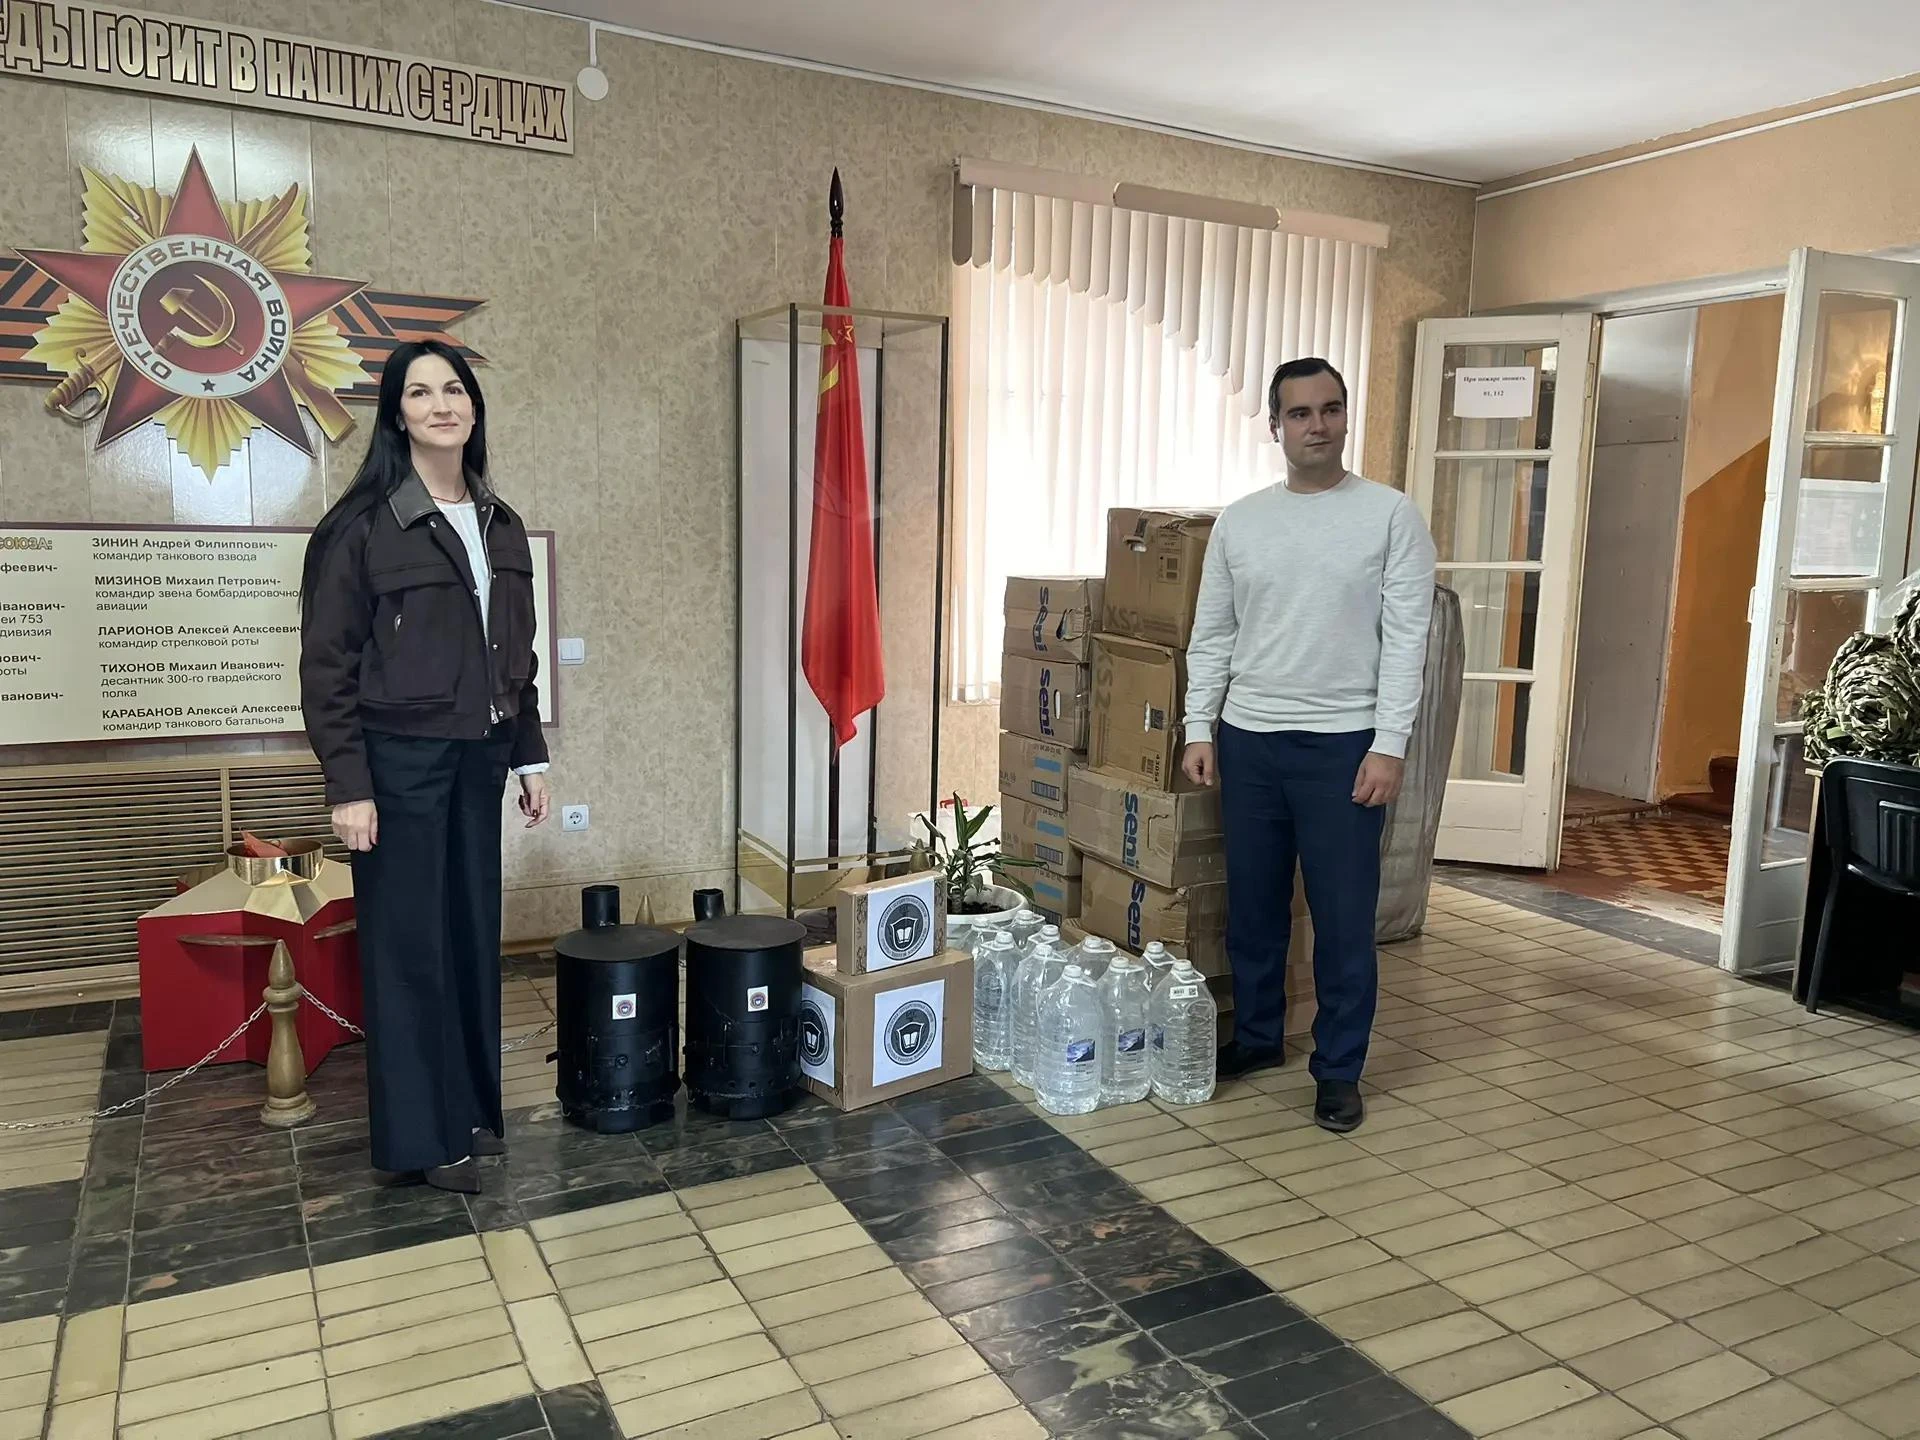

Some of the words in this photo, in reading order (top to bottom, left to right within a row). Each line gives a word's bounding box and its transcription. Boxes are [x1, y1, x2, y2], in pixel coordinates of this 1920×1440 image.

[93, 10, 222, 89] ГОРИТ
[228, 31, 258, 93] В
[263, 37, 404, 118] НАШИХ
[406, 62, 568, 144] СЕРДЦАХ
[116, 241, 272, 381] ОТЕЧЕСТВЕННАЯ
[91, 537, 139, 548] ЗИНИН
[142, 538, 191, 550] Андрей
[194, 539, 278, 549] Филиппович-
[92, 552, 153, 563] командир
[155, 552, 215, 561] танкового
[217, 553, 257, 563] взвода
[94, 575, 162, 586] МИЗИНОВ
[165, 575, 214, 586] Михаил
[217, 576, 281, 588] Петрович-
[95, 590, 155, 600] командир
[158, 590, 193, 598] звена
[196, 589, 300, 600] бомбардировочно
[0, 602, 65, 611] ванович-
[96, 603, 148, 612] авиации
[20, 613, 44, 624] 753
[0, 628, 52, 638] дивизия
[97, 625, 174, 636] ЛАРИОНОВ
[177, 624, 229, 635] Алексей
[98, 640, 159, 650] командир
[161, 637, 228, 649] стрелковой
[231, 638, 259, 648] роты
[99, 662, 166, 674] ТИХОНОВ
[169, 662, 217, 672] Михаил
[220, 661, 285, 671] Иванович-
[100, 676, 164, 687] десантник
[166, 673, 204, 684] 300-го
[207, 672, 282, 684] гвардейского
[102, 689, 137, 699] полка
[1039, 667, 1055, 737] seni
[102, 706, 183, 719] КАРАБАНОВ
[186, 705, 238, 716] Алексей
[242, 704, 302, 713] Алексееви
[102, 721, 162, 732] командир
[164, 719, 223, 729] танкового
[226, 717, 284, 726] батальона
[1122, 791, 1140, 869] seni
[1127, 879, 1146, 949] sen
